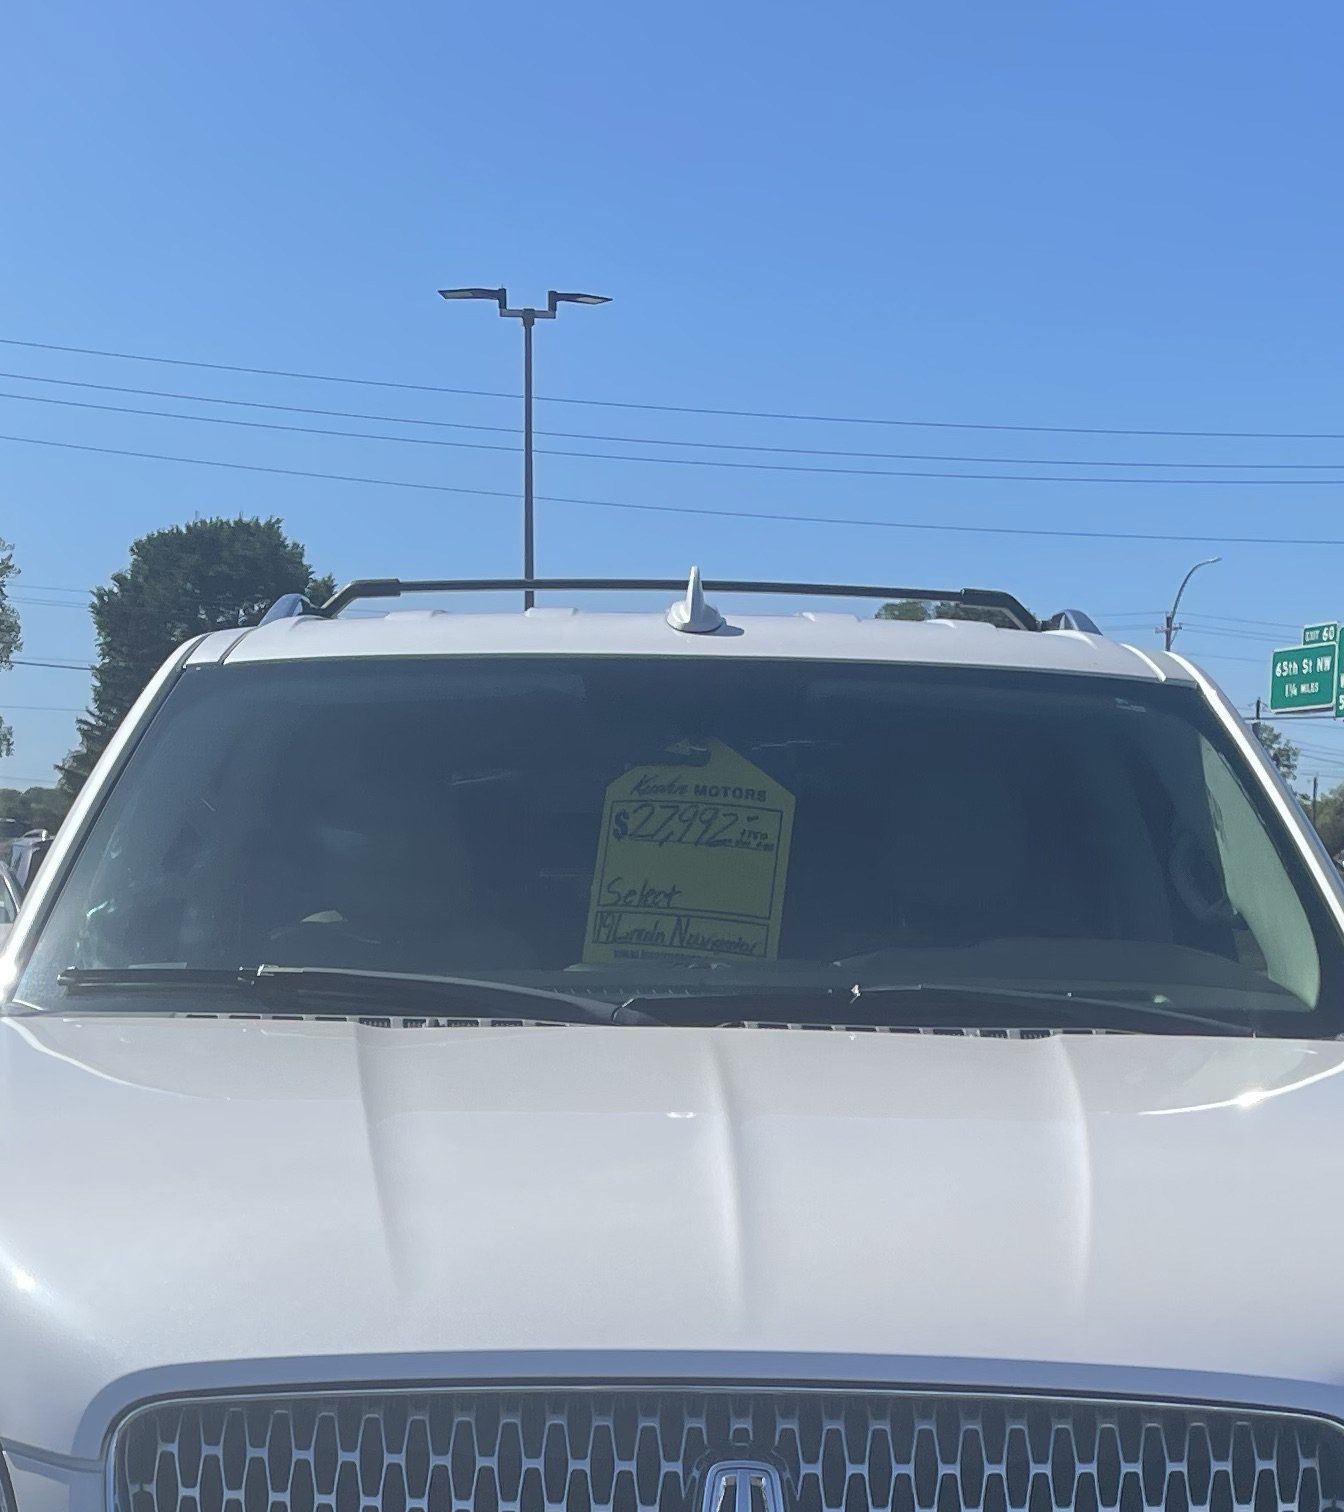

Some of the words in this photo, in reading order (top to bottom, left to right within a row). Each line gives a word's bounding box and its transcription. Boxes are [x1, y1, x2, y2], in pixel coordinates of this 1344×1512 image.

[1322, 626, 1335, 641] 60
[1275, 660, 1299, 677] 65th
[1302, 658, 1313, 674] St
[1316, 656, 1332, 672] NW
[694, 784, 768, 802] MOTORS
[607, 876, 683, 908] Select
